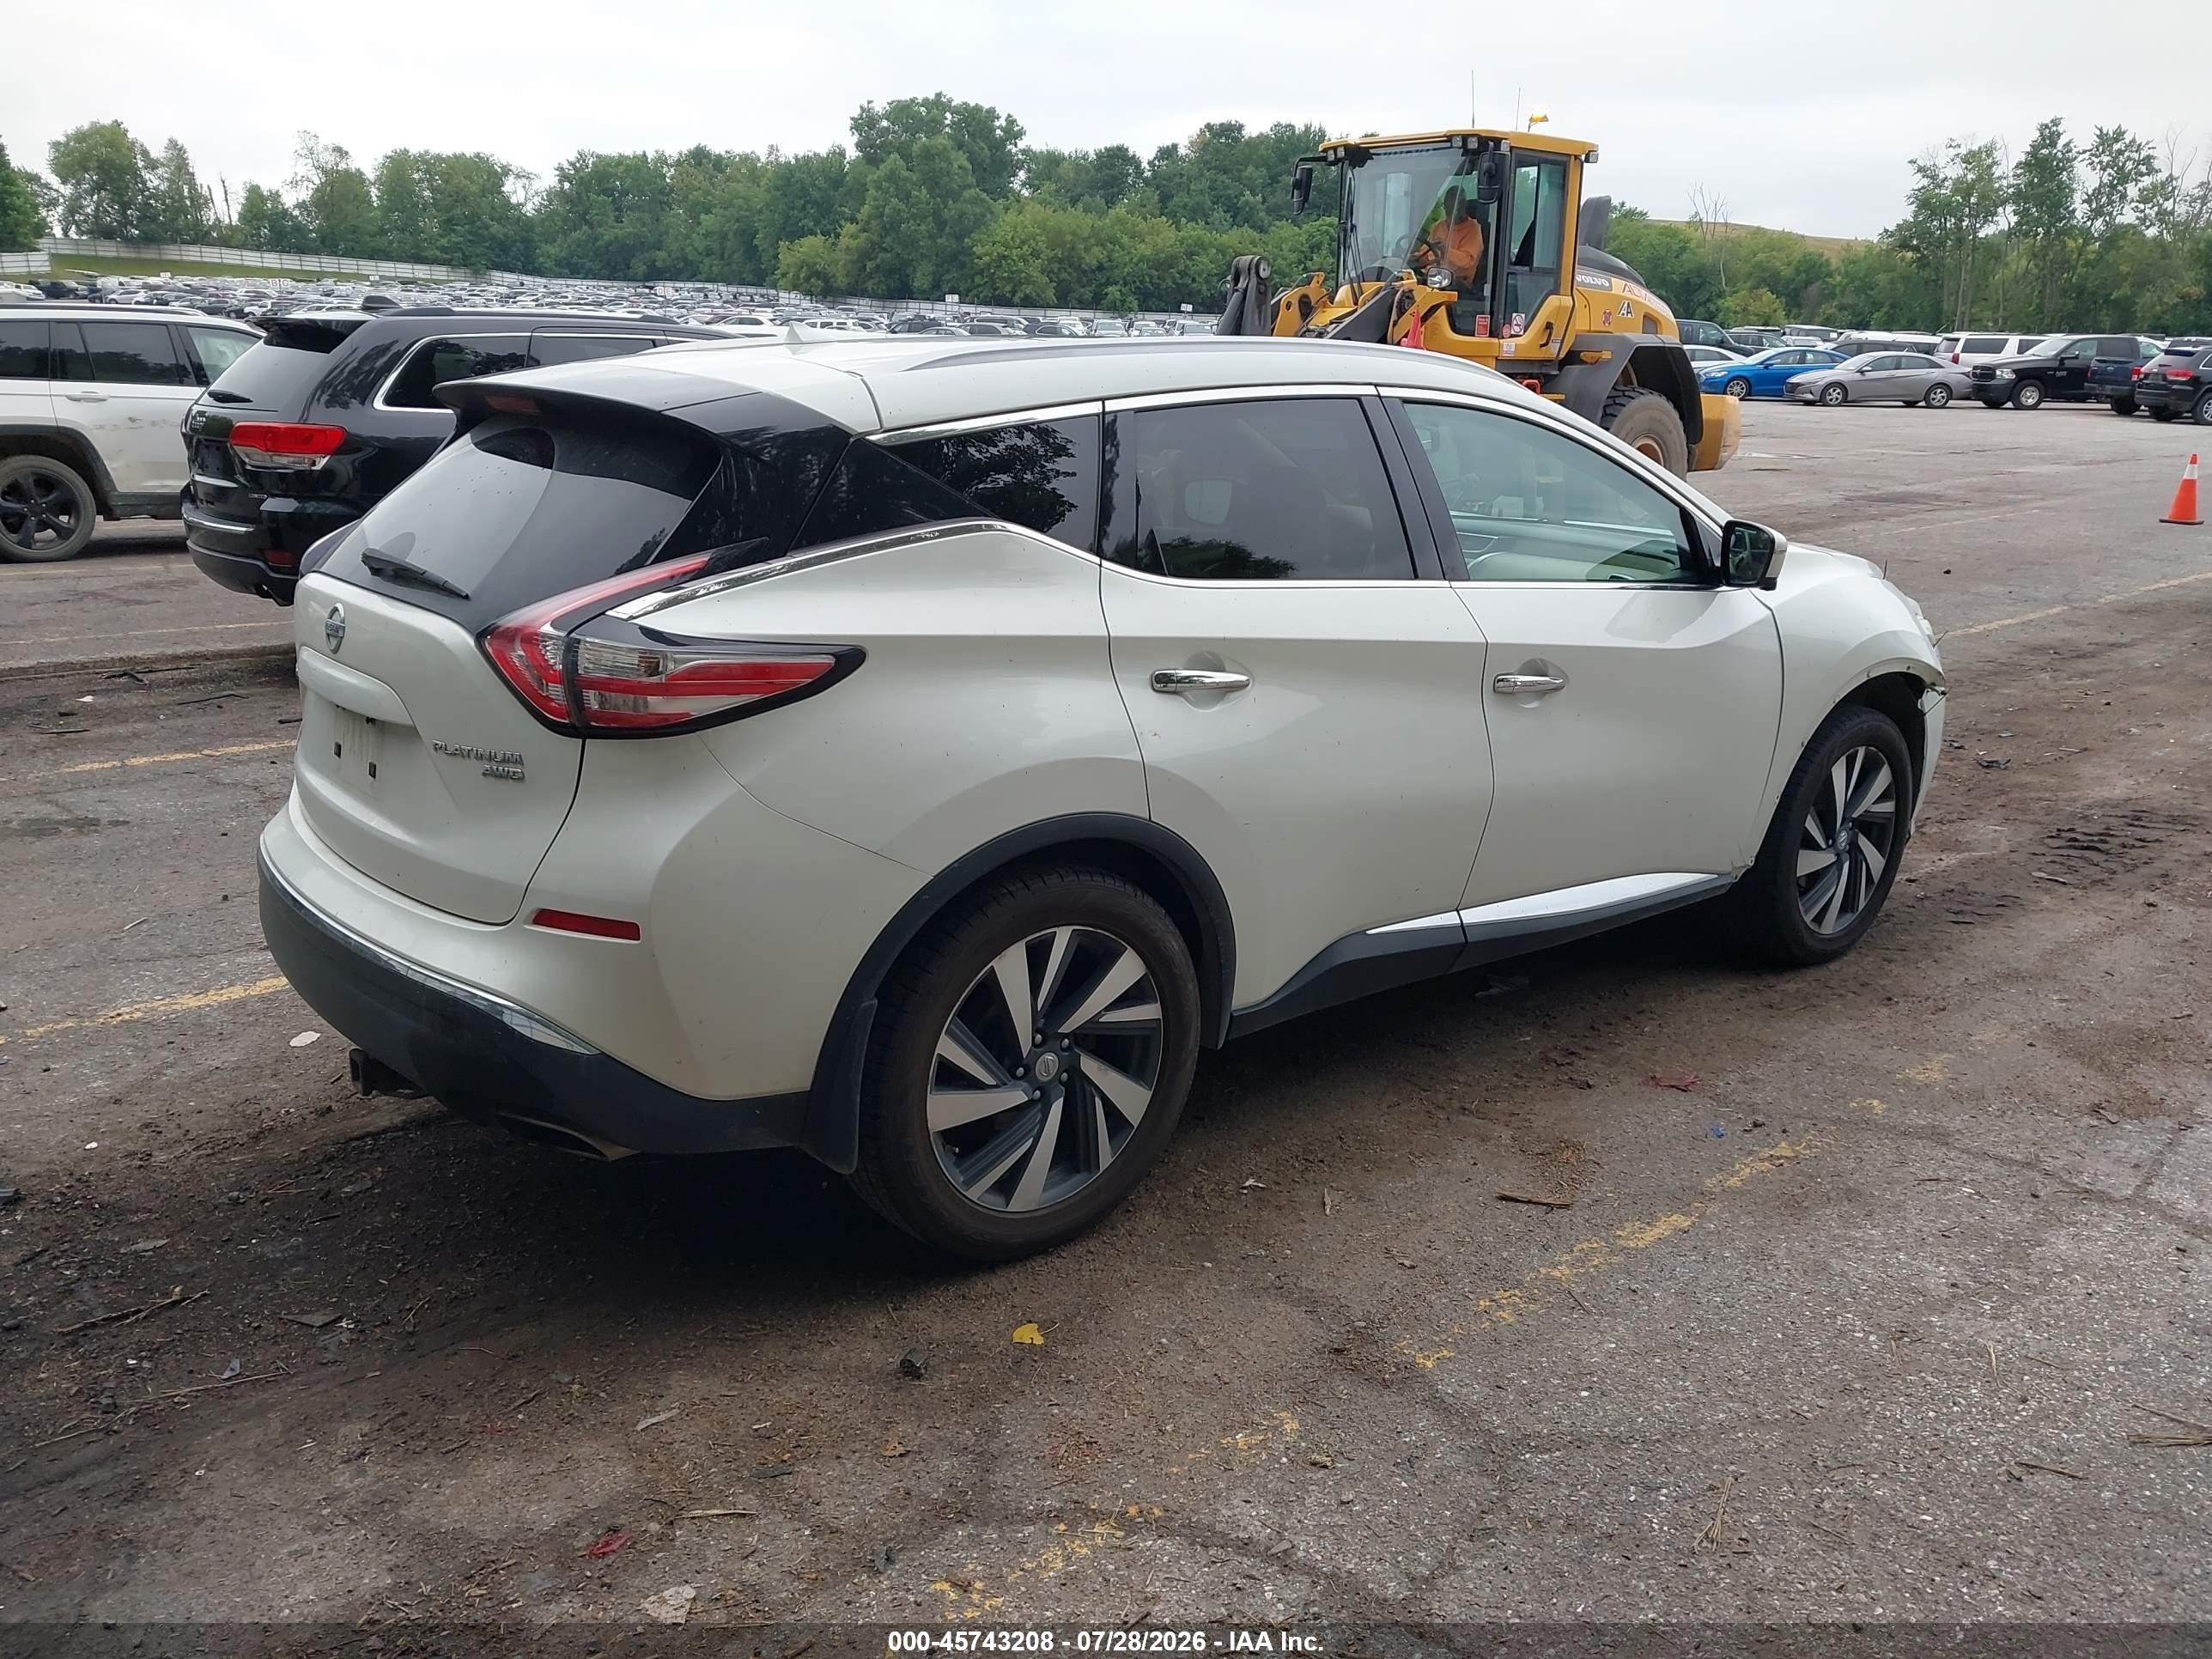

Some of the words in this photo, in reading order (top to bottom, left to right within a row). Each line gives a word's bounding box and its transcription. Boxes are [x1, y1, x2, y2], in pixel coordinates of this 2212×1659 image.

[1575, 274, 1610, 287] VOLVO
[432, 738, 524, 766] PLATINUM
[481, 764, 526, 781] AWD
